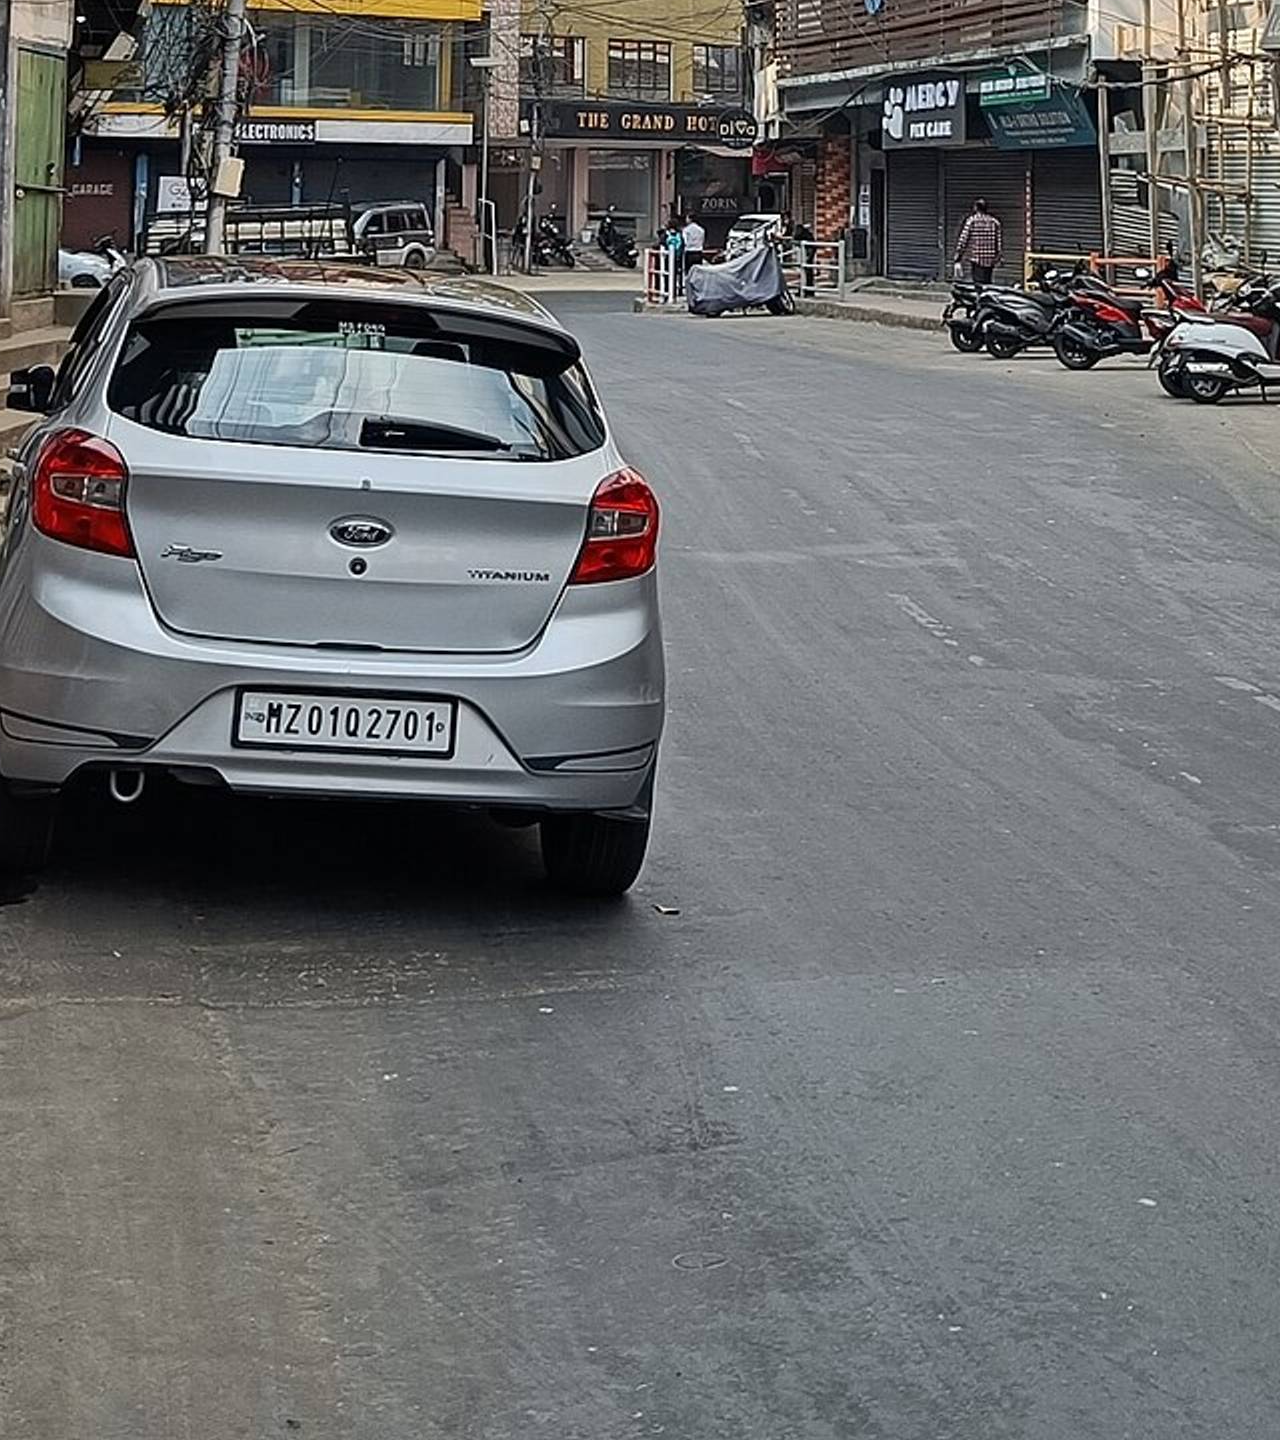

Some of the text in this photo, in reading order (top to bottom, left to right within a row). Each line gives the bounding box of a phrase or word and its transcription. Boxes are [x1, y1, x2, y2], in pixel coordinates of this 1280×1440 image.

[904, 79, 960, 111] MERCY
[576, 111, 718, 132] THE GRAND HOT
[701, 197, 739, 210] ZORIN
[467, 568, 551, 583] TITANIUM
[265, 701, 437, 742] MZ01Q2701
